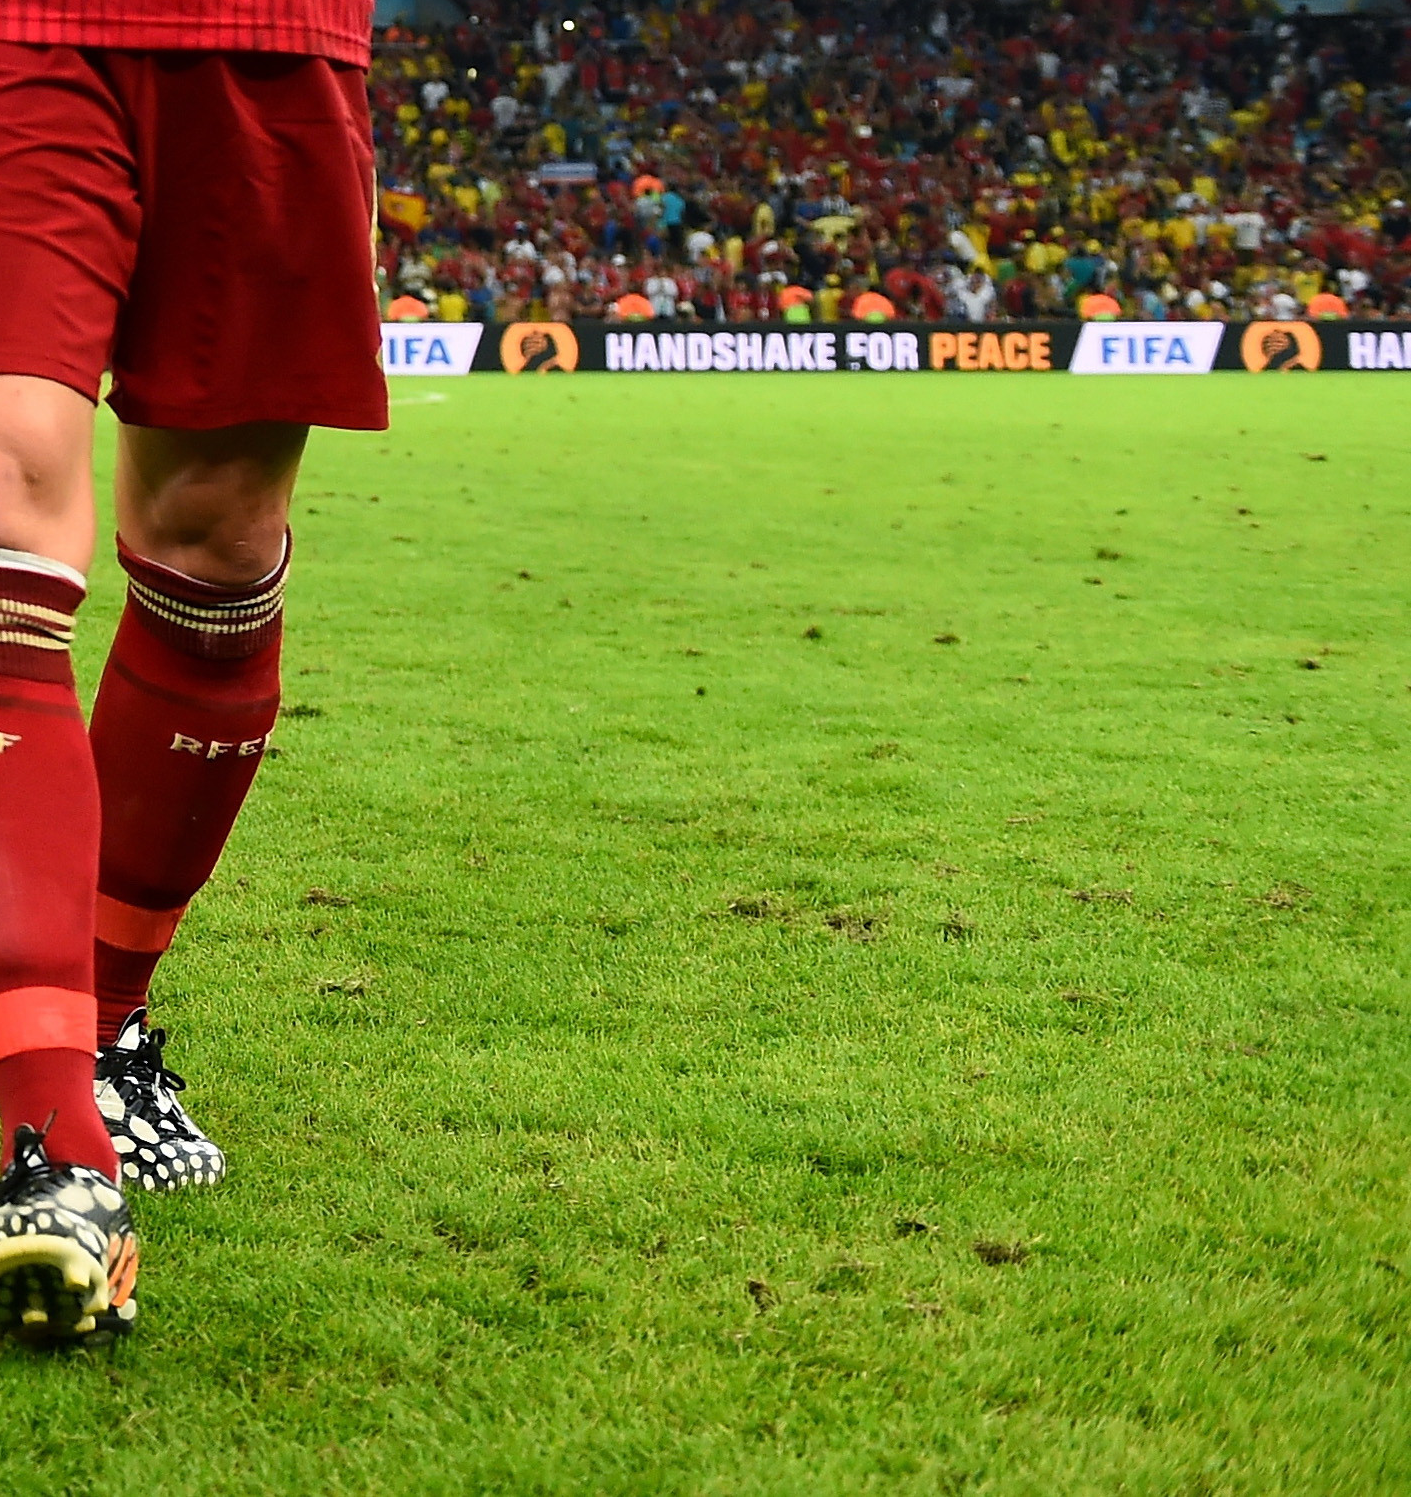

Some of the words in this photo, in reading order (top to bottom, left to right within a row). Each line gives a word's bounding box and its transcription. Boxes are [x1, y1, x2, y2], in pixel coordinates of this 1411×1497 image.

[605, 332, 837, 372] HANDSHAKE
[845, 332, 920, 371] FOR
[930, 332, 1052, 371] PEACE
[1101, 335, 1192, 366] FIFA
